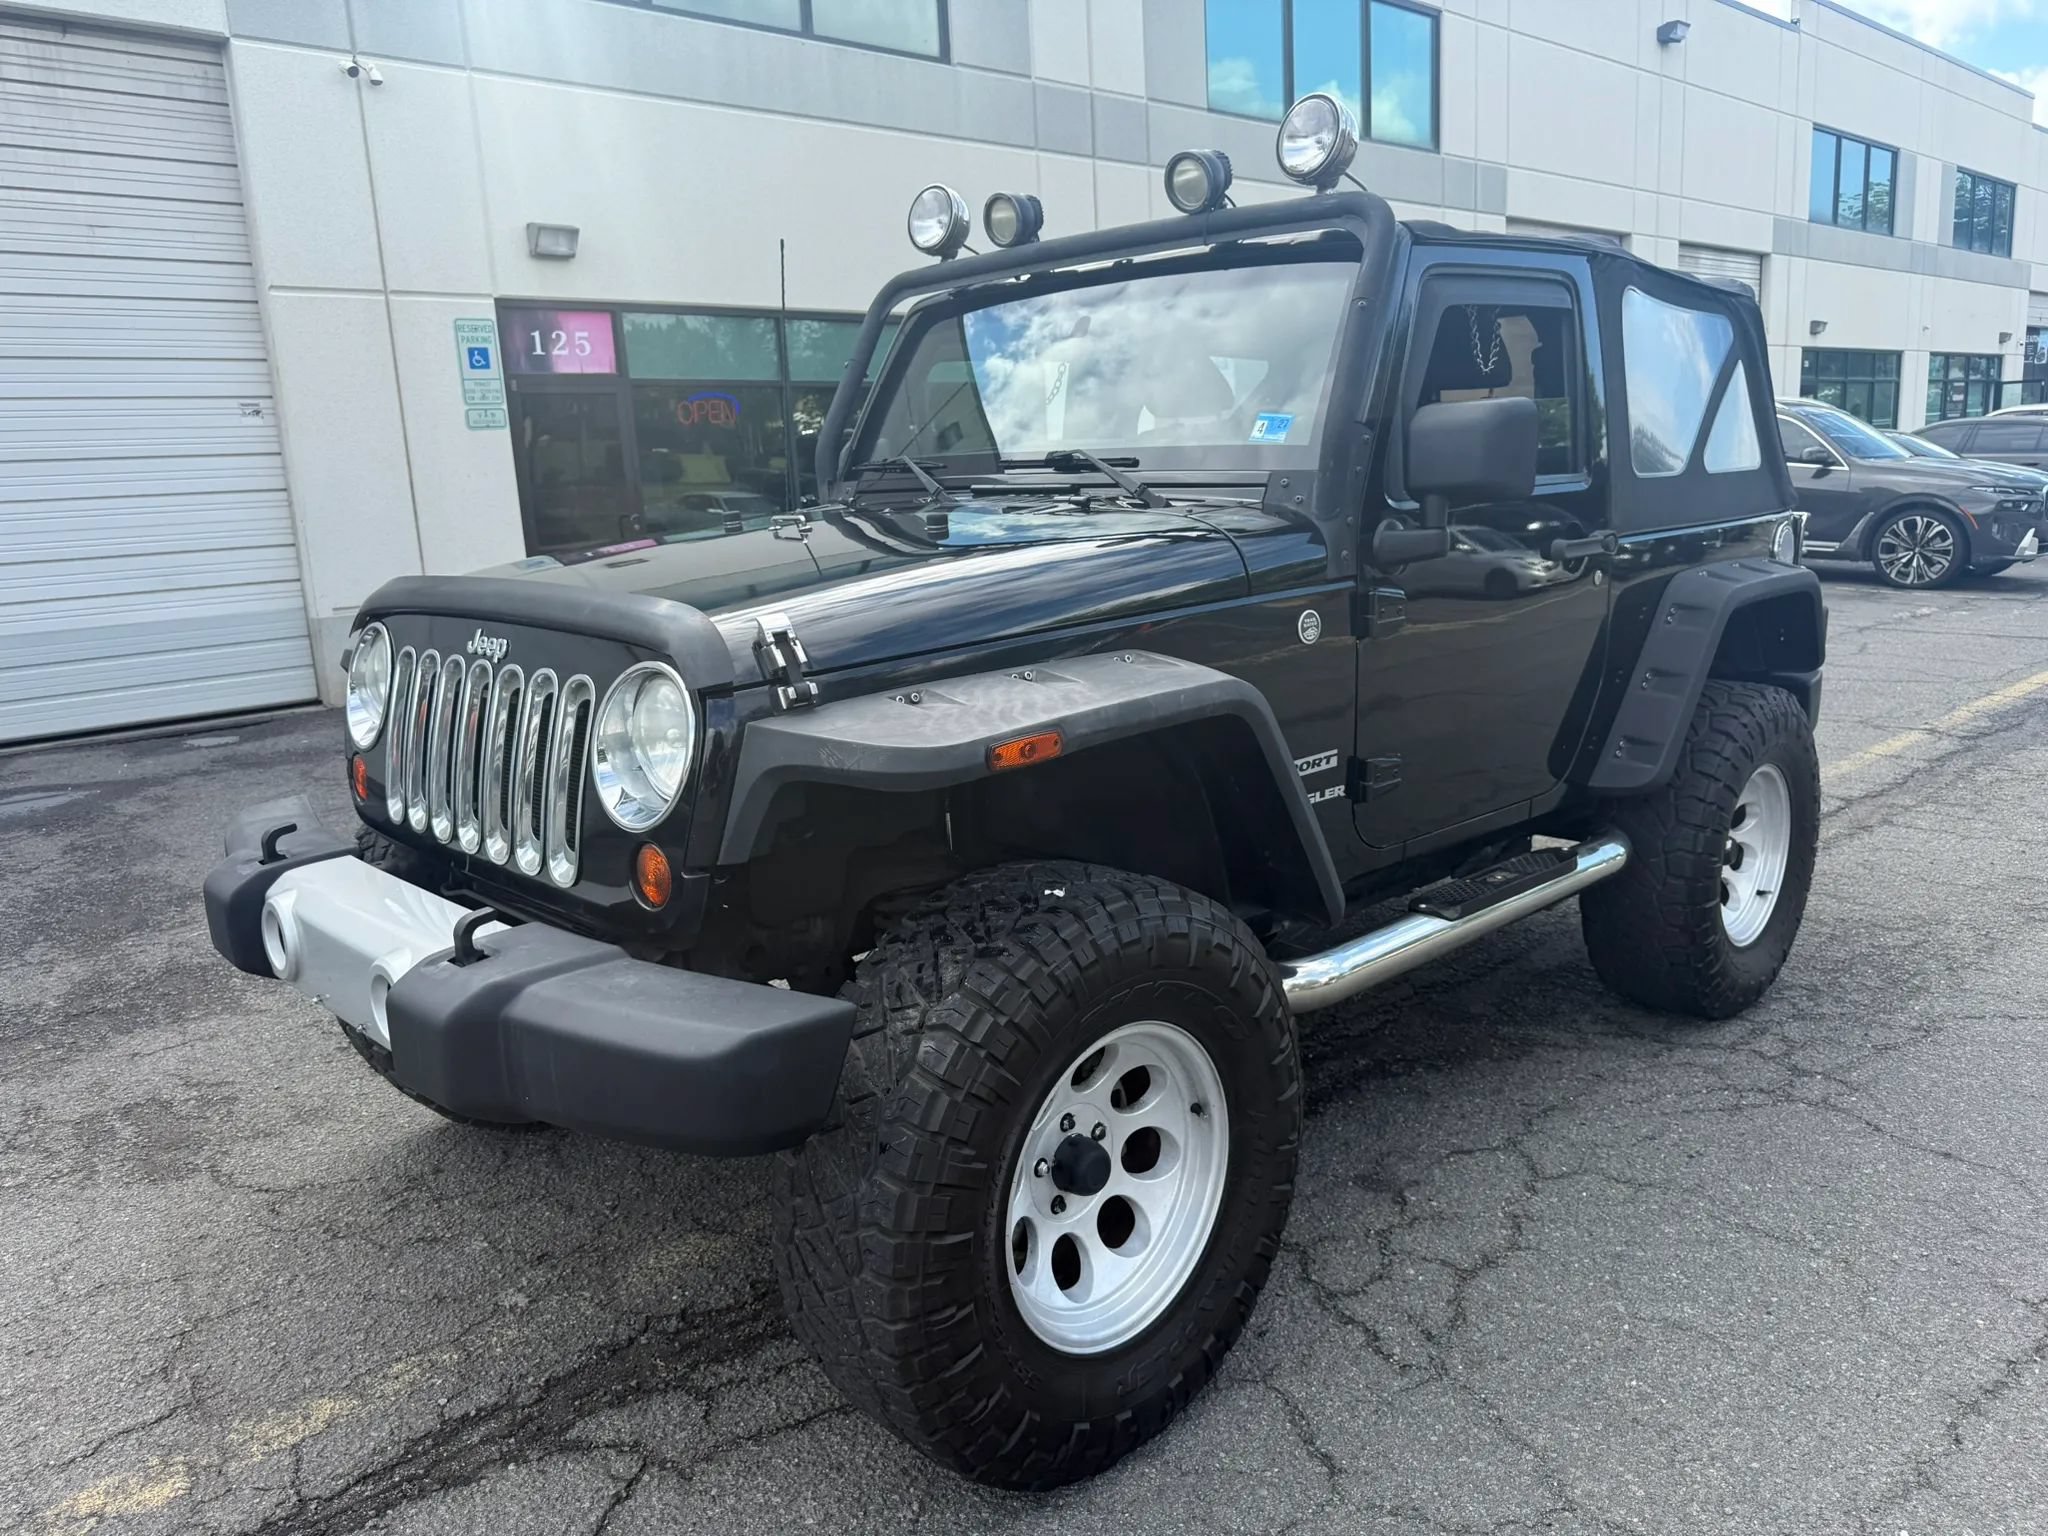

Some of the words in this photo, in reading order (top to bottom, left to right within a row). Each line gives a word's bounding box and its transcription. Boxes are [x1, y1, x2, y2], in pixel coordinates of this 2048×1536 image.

[457, 324, 492, 333] RESERVED
[460, 335, 492, 345] PARKING
[530, 330, 591, 356] 125
[677, 400, 736, 427] OPEN
[1257, 422, 1265, 434] 4
[467, 628, 508, 663] Jeep
[1296, 755, 1335, 772] ORT
